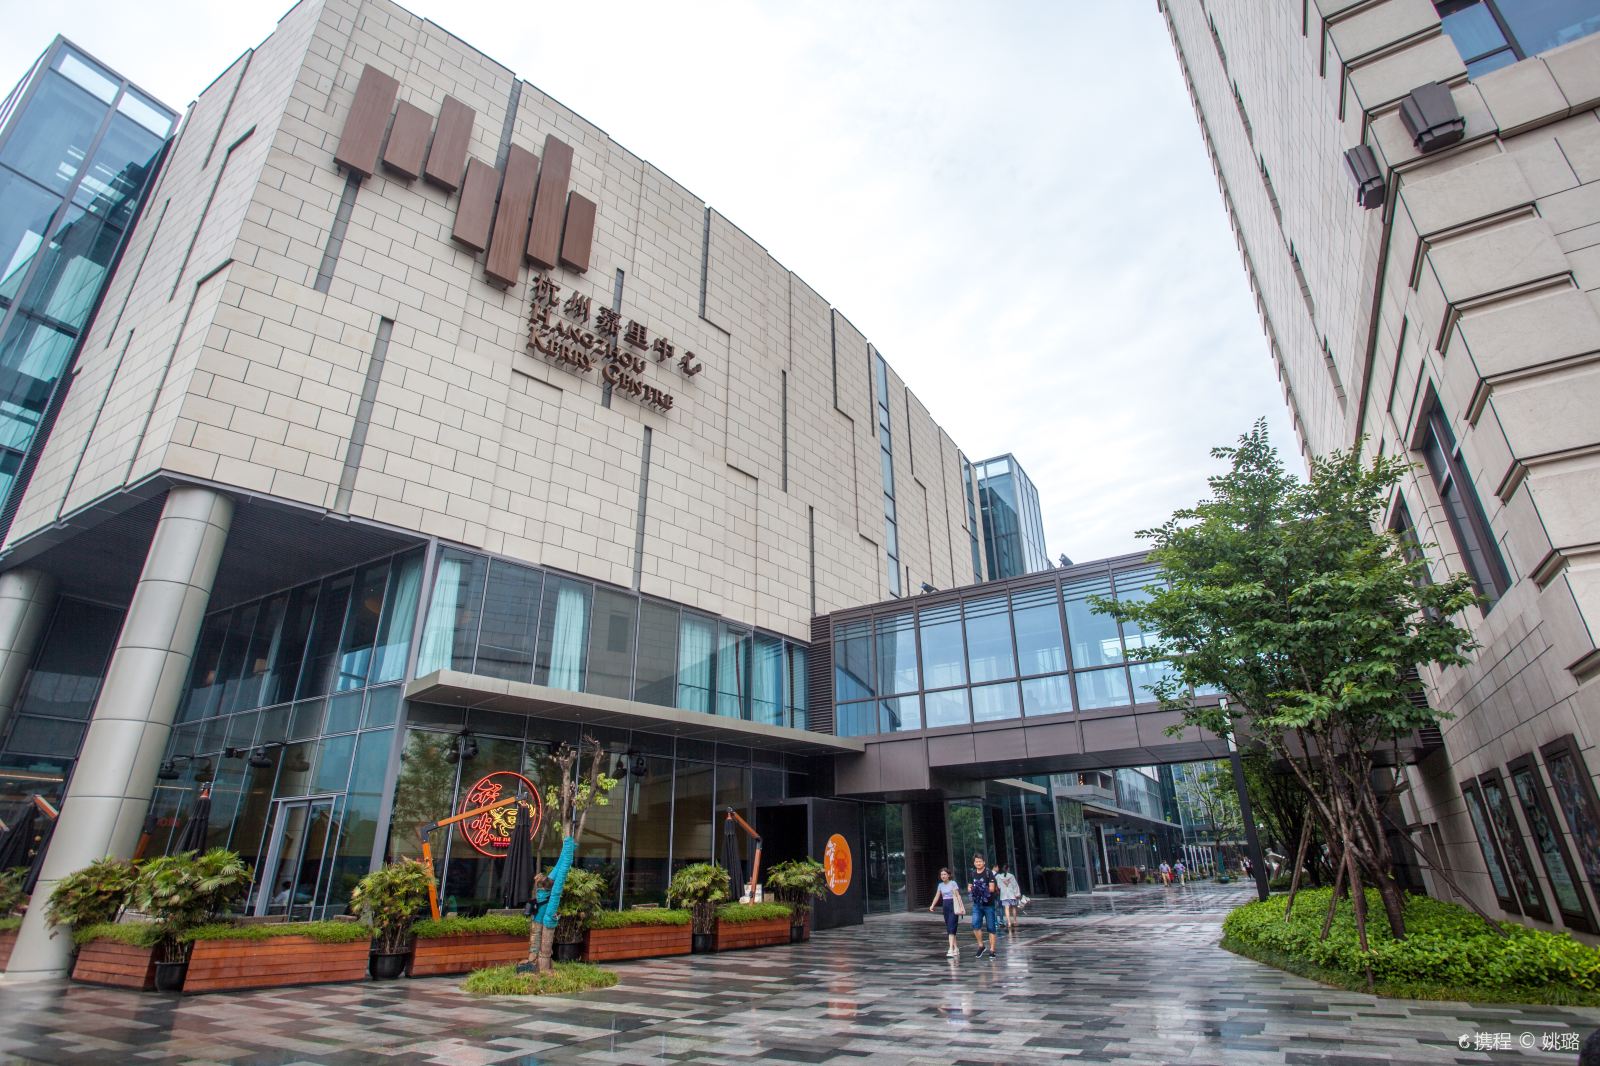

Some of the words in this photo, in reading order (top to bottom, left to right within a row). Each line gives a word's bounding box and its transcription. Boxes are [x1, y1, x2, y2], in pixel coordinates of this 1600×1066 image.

[528, 303, 646, 375] HANGZHOU
[531, 273, 701, 377] 杭州嘉里中心
[527, 327, 596, 373] KERRY
[602, 364, 674, 412] CENTRE
